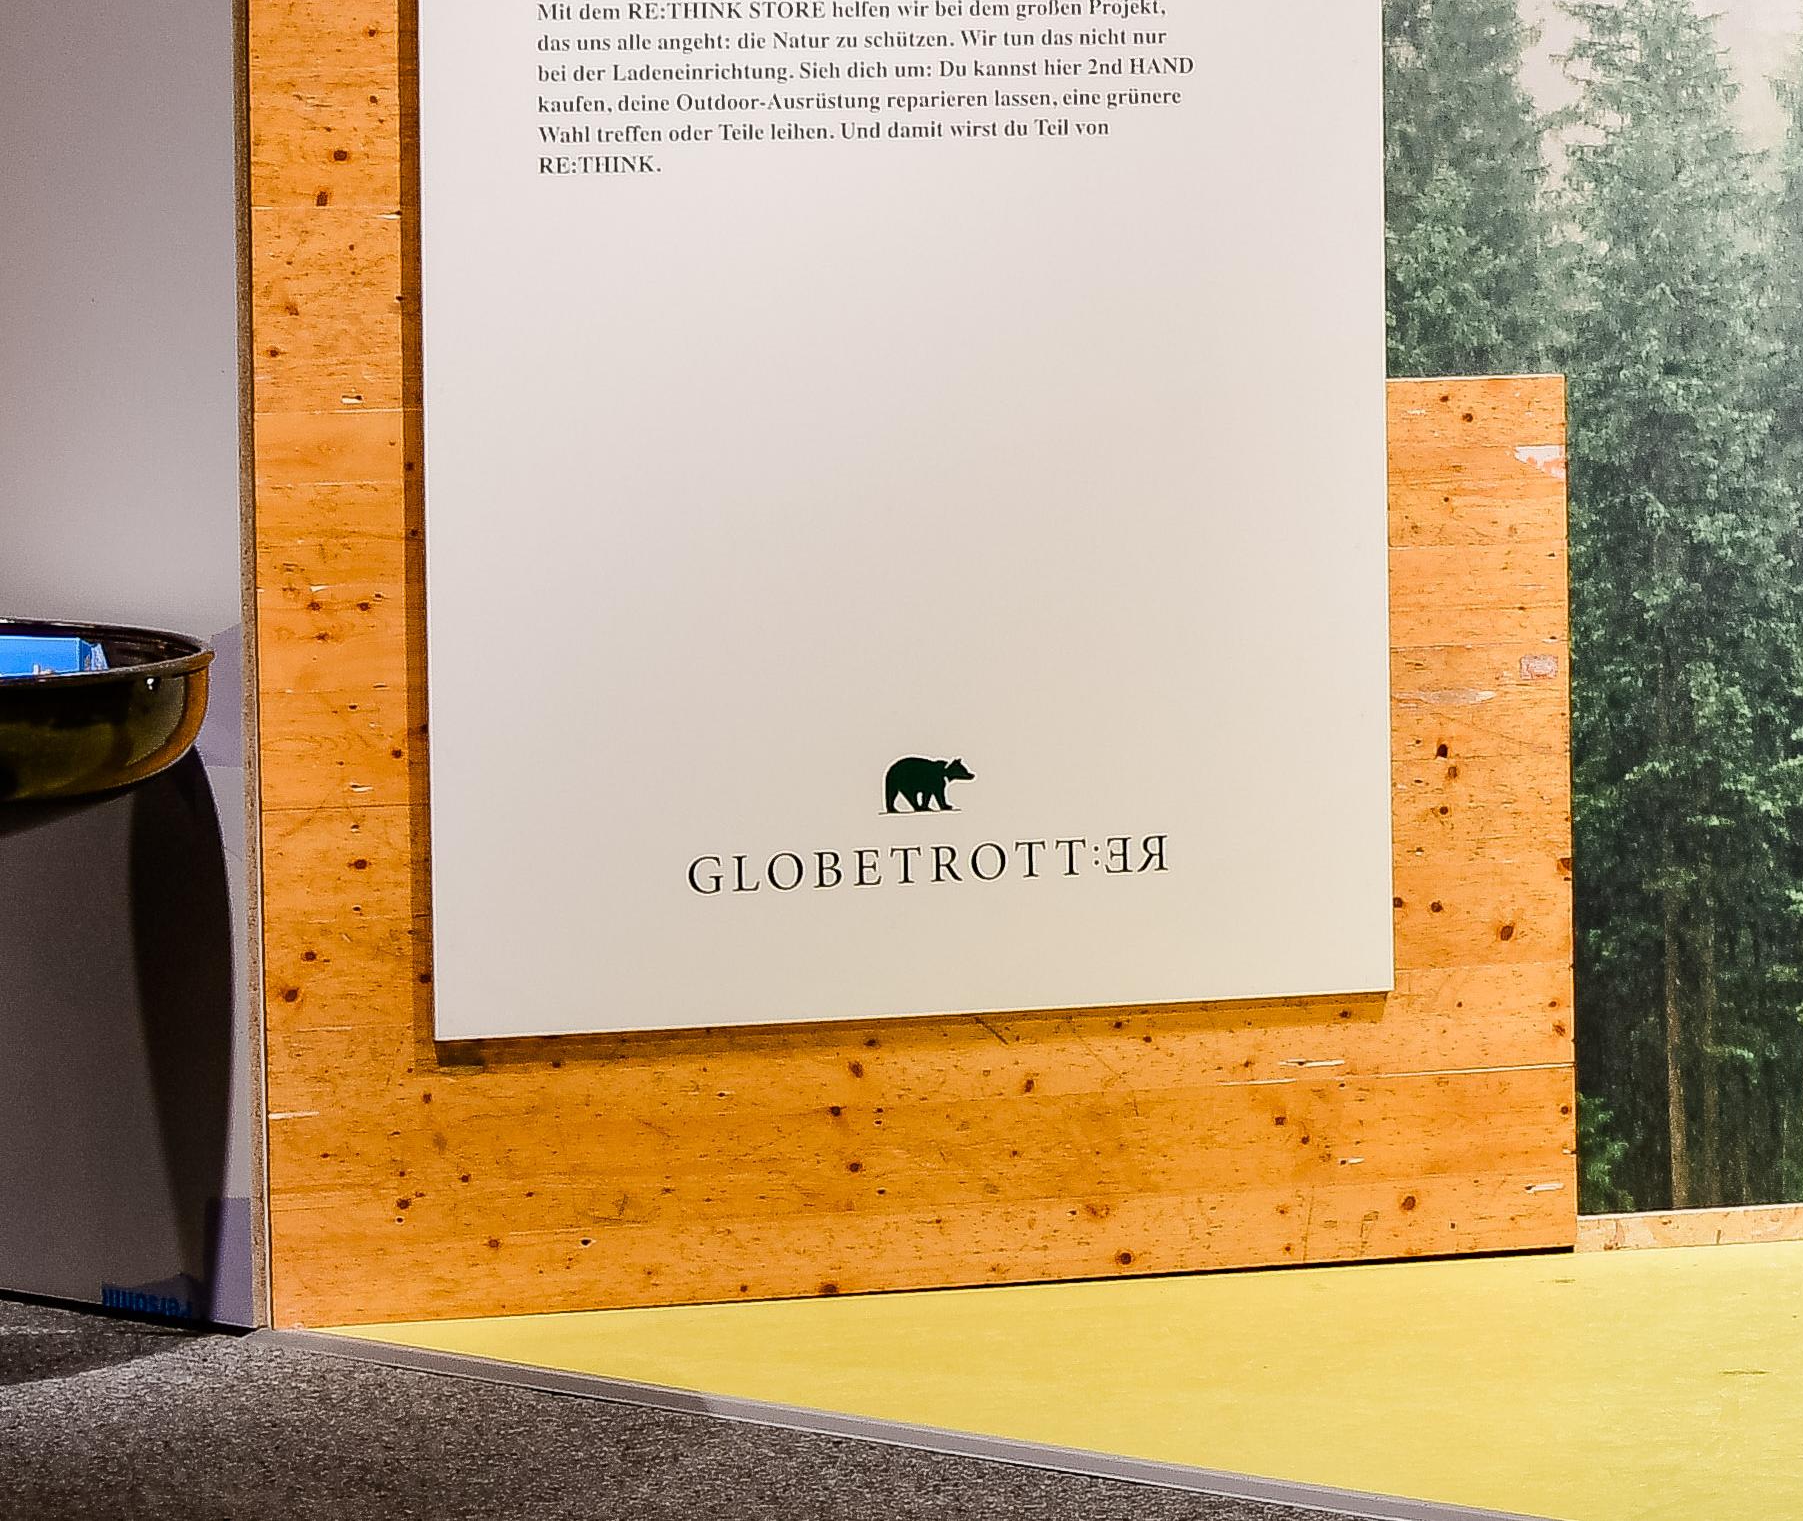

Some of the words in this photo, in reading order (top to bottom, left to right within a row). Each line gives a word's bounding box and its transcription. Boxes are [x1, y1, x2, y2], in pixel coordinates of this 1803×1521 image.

[537, 3, 572, 21] Mit
[579, 3, 621, 21] dem
[628, 1, 743, 21] RE:THINK
[748, 0, 826, 20] STORE
[832, 0, 890, 19] helfen
[897, 0, 930, 18] wir
[934, 0, 963, 17] bei
[969, 0, 1010, 17] dem
[537, 34, 571, 52] das
[576, 38, 611, 51] uns
[617, 33, 652, 51] alle
[657, 32, 730, 55] angeht:
[737, 31, 766, 50] die
[773, 31, 831, 49] Natur
[835, 35, 858, 48] zu
[863, 30, 955, 49] schützen.
[960, 29, 998, 47] Wir
[1003, 31, 1035, 47] tun
[1041, 28, 1073, 46] das
[1079, 27, 1126, 46] nicht
[1132, 32, 1168, 45] nur
[537, 64, 567, 83] bei
[572, 64, 607, 82] der
[612, 62, 795, 85] Ladeneinrichtung.
[799, 61, 841, 80] Sieh
[847, 61, 888, 79] dich
[894, 65, 932, 78] um:
[939, 60, 967, 78] Du
[973, 59, 1038, 77] kannst
[1044, 58, 1083, 76] hier
[1087, 57, 1123, 76] 2nd
[1128, 56, 1194, 76] HAND
[538, 95, 613, 113] kaufen,
[617, 94, 670, 112] deine
[676, 92, 881, 114] Outdoor-Ausrüstung
[887, 90, 988, 113] reparieren
[994, 89, 1058, 107] lassen,
[1062, 88, 1101, 106] eine
[1106, 87, 1182, 110] grünere
[538, 125, 590, 144] Wahl
[597, 124, 662, 144] treffen
[668, 124, 714, 142] oder
[717, 123, 764, 141] Teile
[770, 122, 835, 141] leihen.
[840, 121, 881, 140] Und
[887, 120, 943, 139] damit
[949, 120, 998, 138] wirst
[1003, 119, 1028, 137] du
[1033, 118, 1069, 136] Teil
[1074, 122, 1109, 136] von
[539, 154, 662, 175] RE:THINK.
